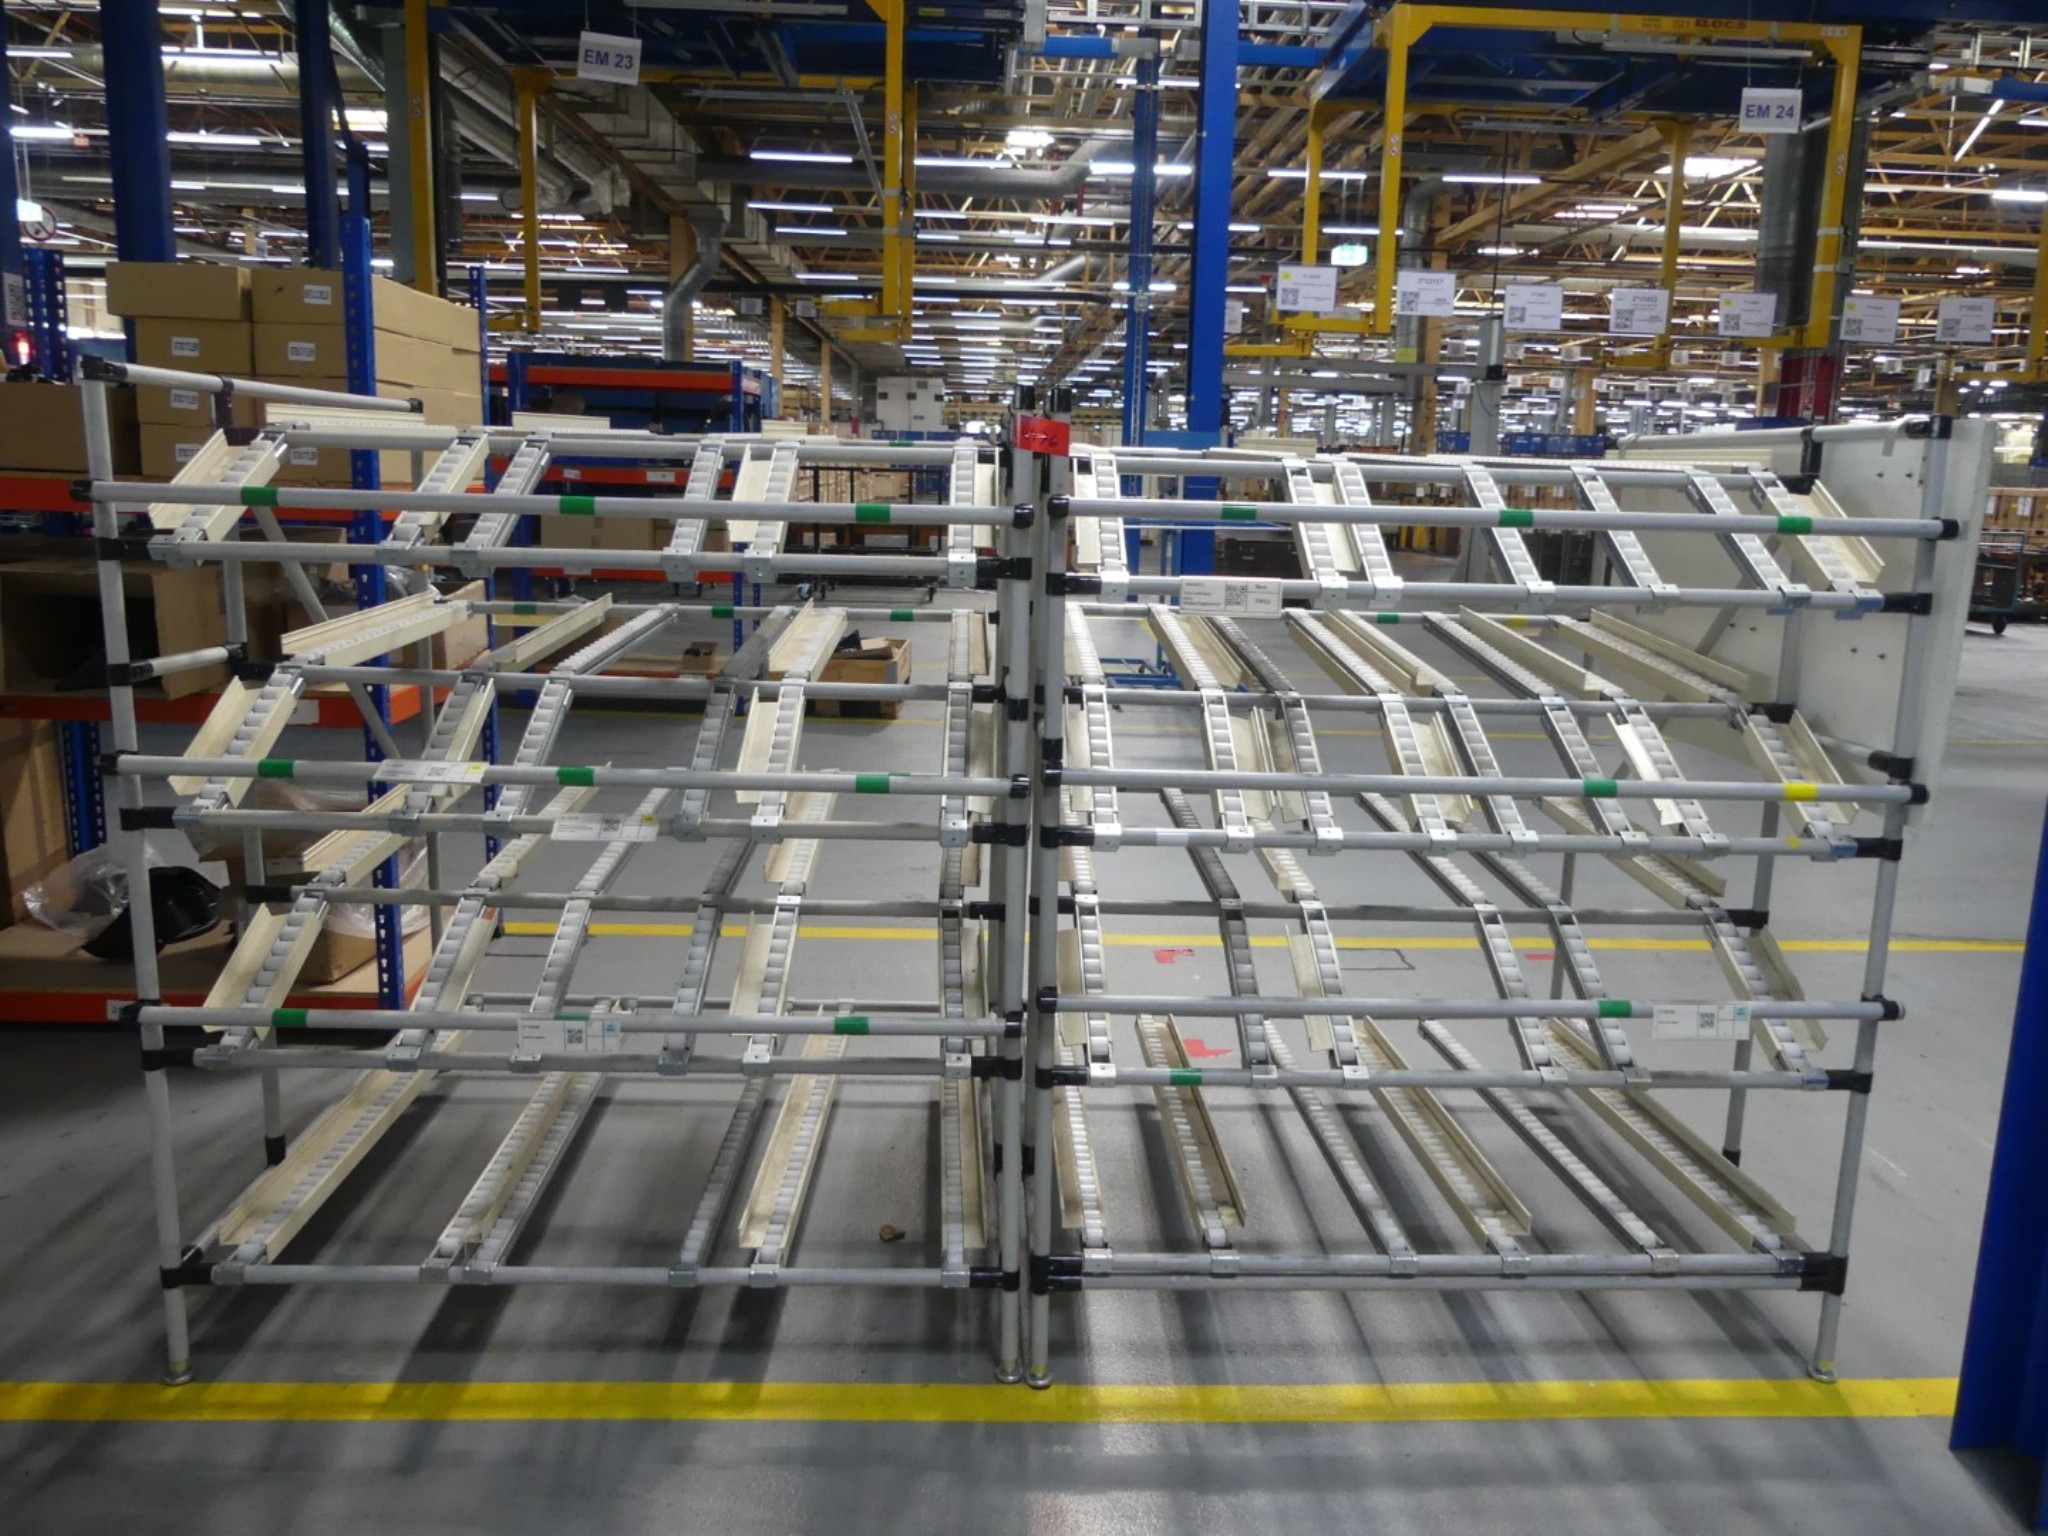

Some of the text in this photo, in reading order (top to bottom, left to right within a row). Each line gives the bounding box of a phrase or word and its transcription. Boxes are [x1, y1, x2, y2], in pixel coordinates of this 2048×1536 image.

[584, 48, 634, 69] EM 23
[1746, 104, 1794, 119] EM 24
